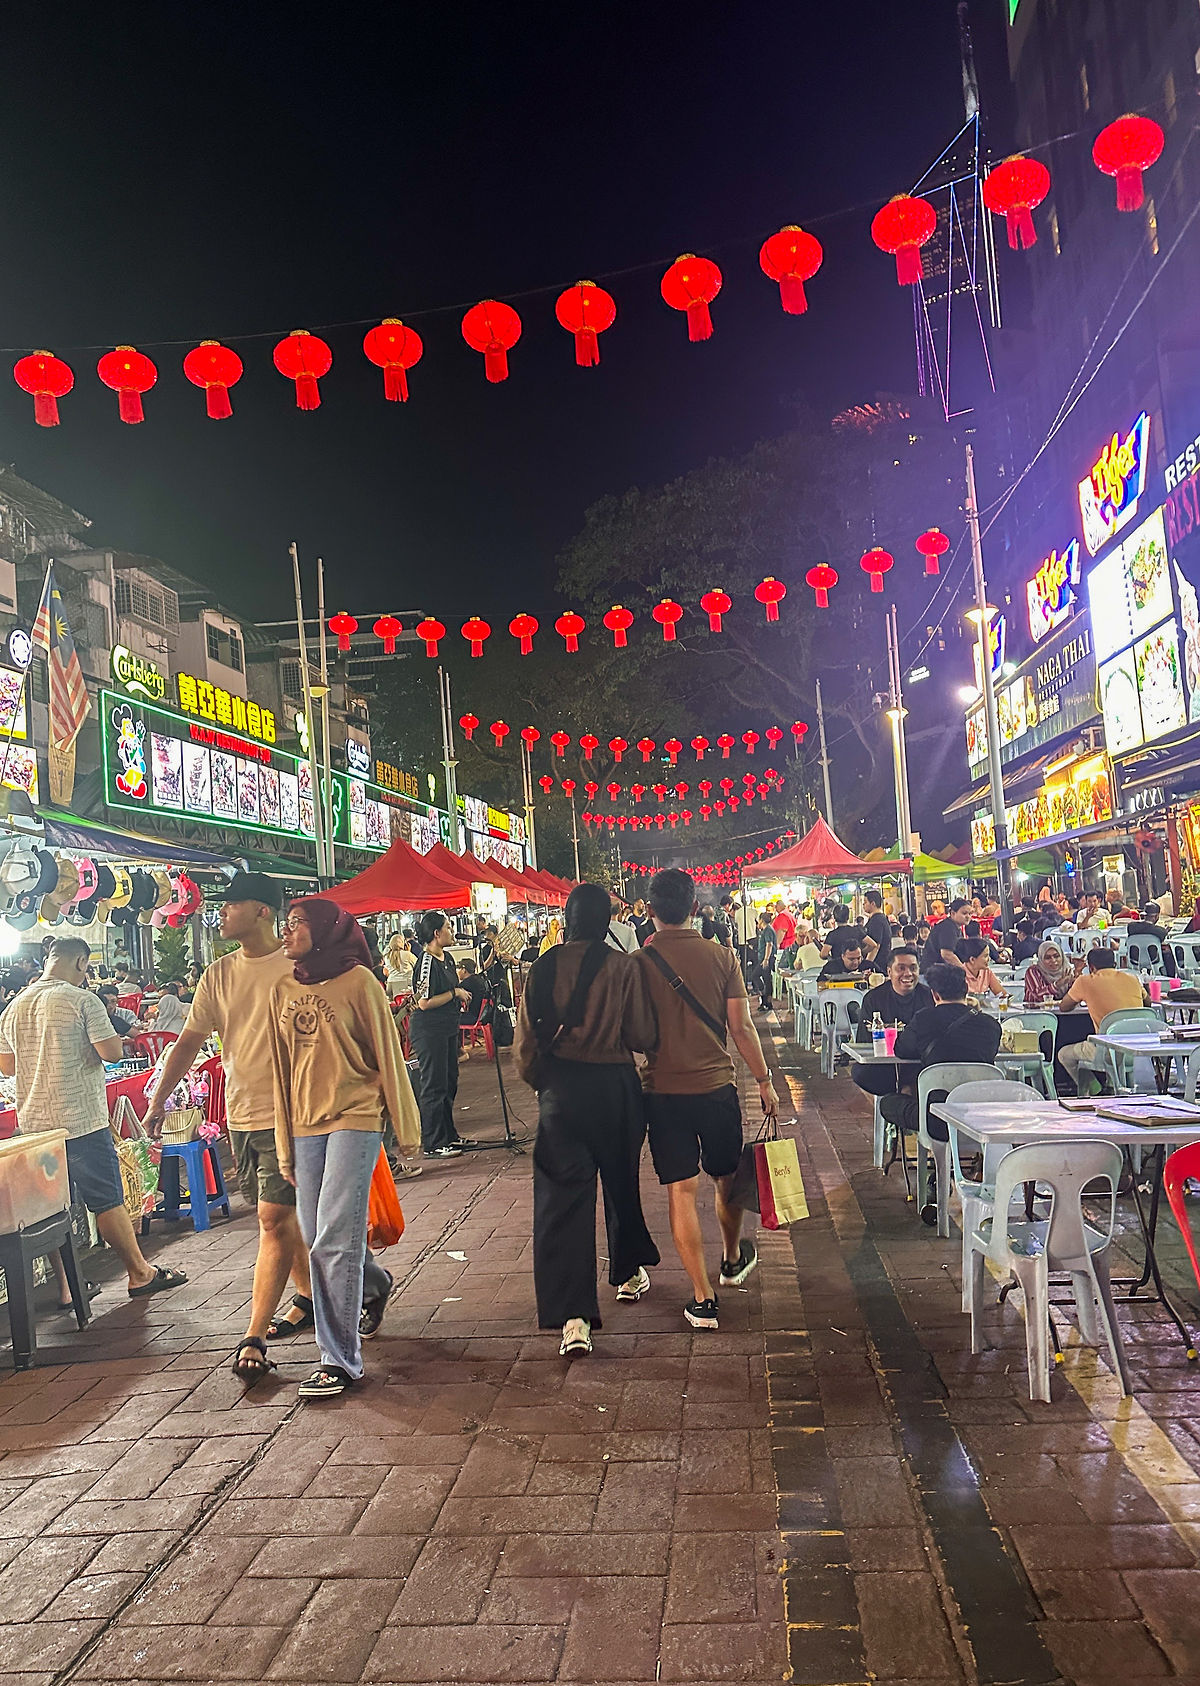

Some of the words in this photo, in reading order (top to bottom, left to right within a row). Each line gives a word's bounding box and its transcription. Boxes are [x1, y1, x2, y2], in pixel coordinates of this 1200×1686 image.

[1092, 432, 1136, 505] Tiger
[1036, 549, 1068, 608] Tiger
[113, 644, 165, 697] Carlsberg
[1036, 652, 1063, 689] NAGA
[1062, 629, 1091, 670] THAI
[280, 994, 336, 1024] HAMPTONS
